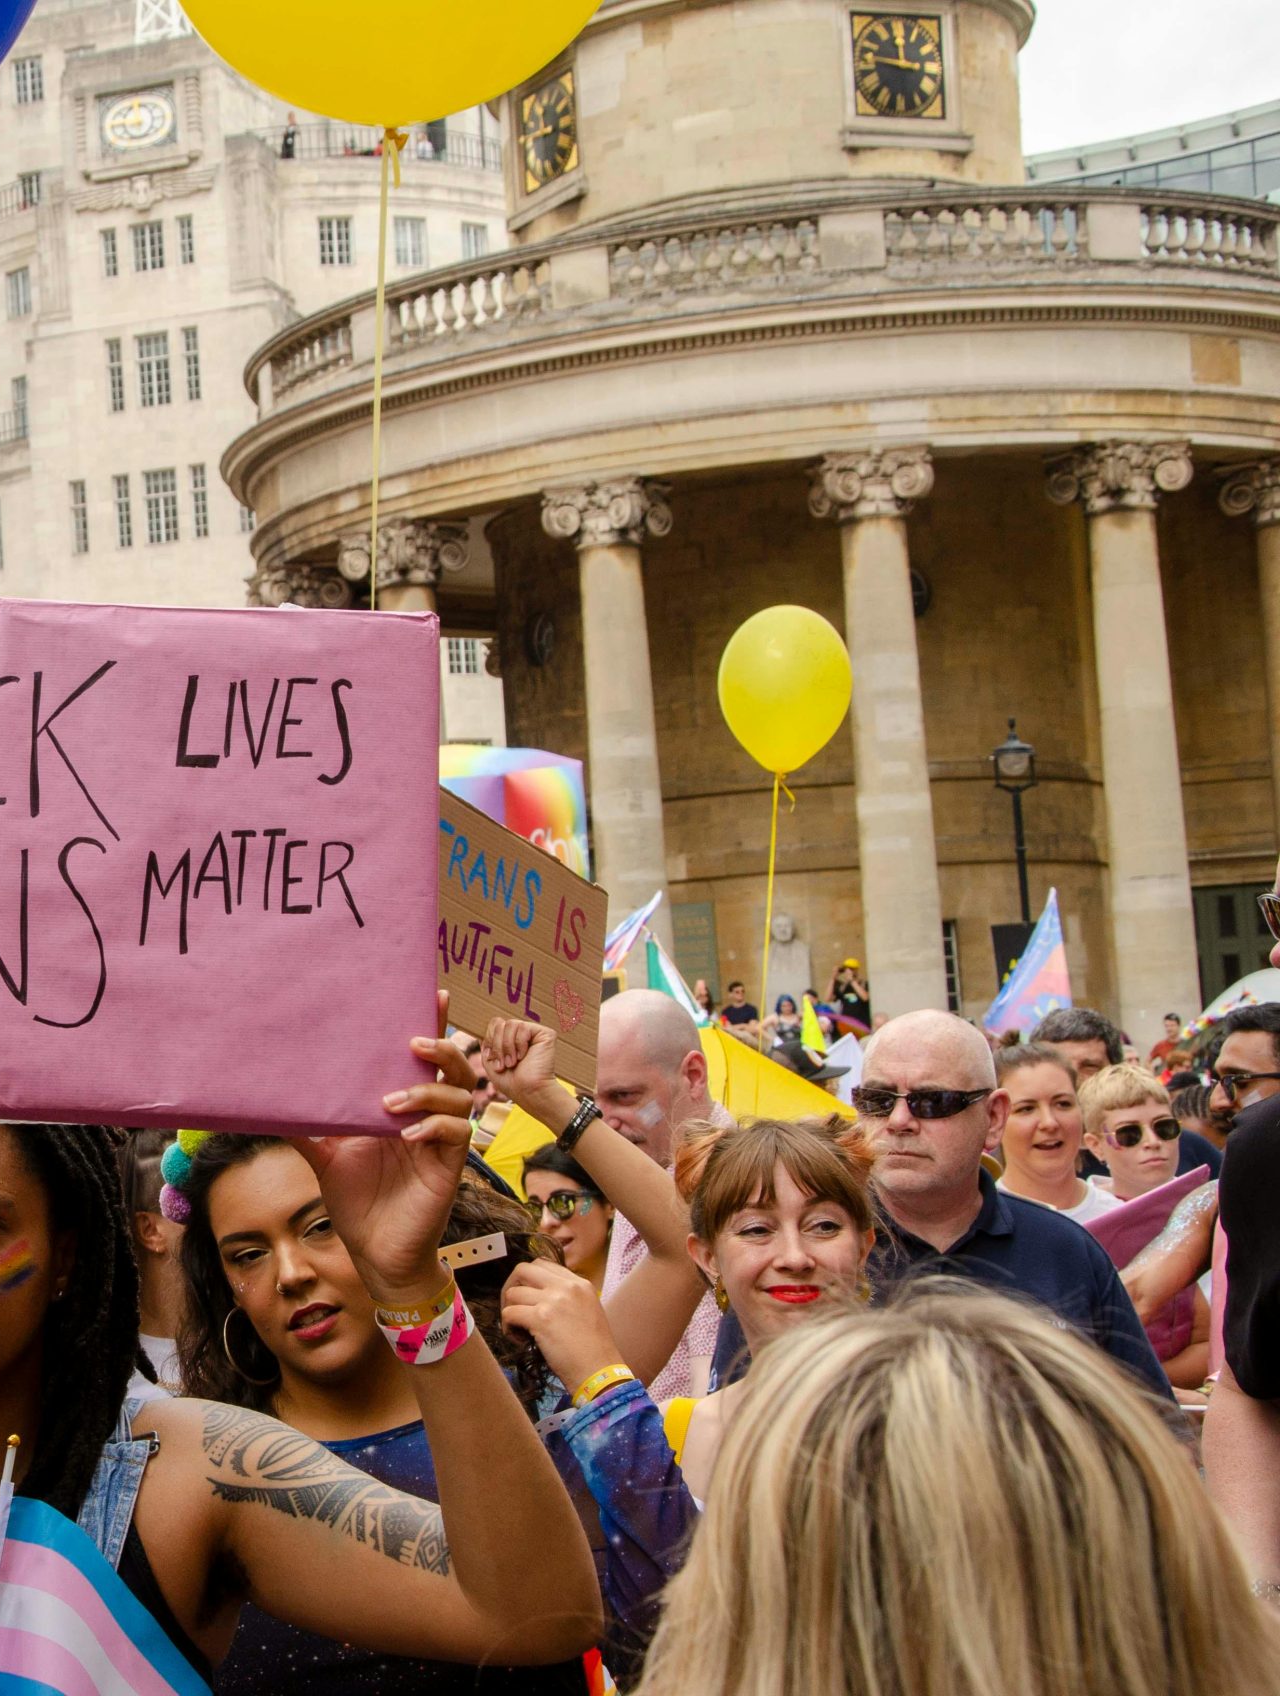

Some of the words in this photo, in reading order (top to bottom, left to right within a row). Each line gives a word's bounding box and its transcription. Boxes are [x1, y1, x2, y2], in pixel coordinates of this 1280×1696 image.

[176, 675, 354, 786] LIVES
[139, 829, 365, 955] MATTER
[439, 819, 543, 930] RANS
[553, 895, 587, 962] IS
